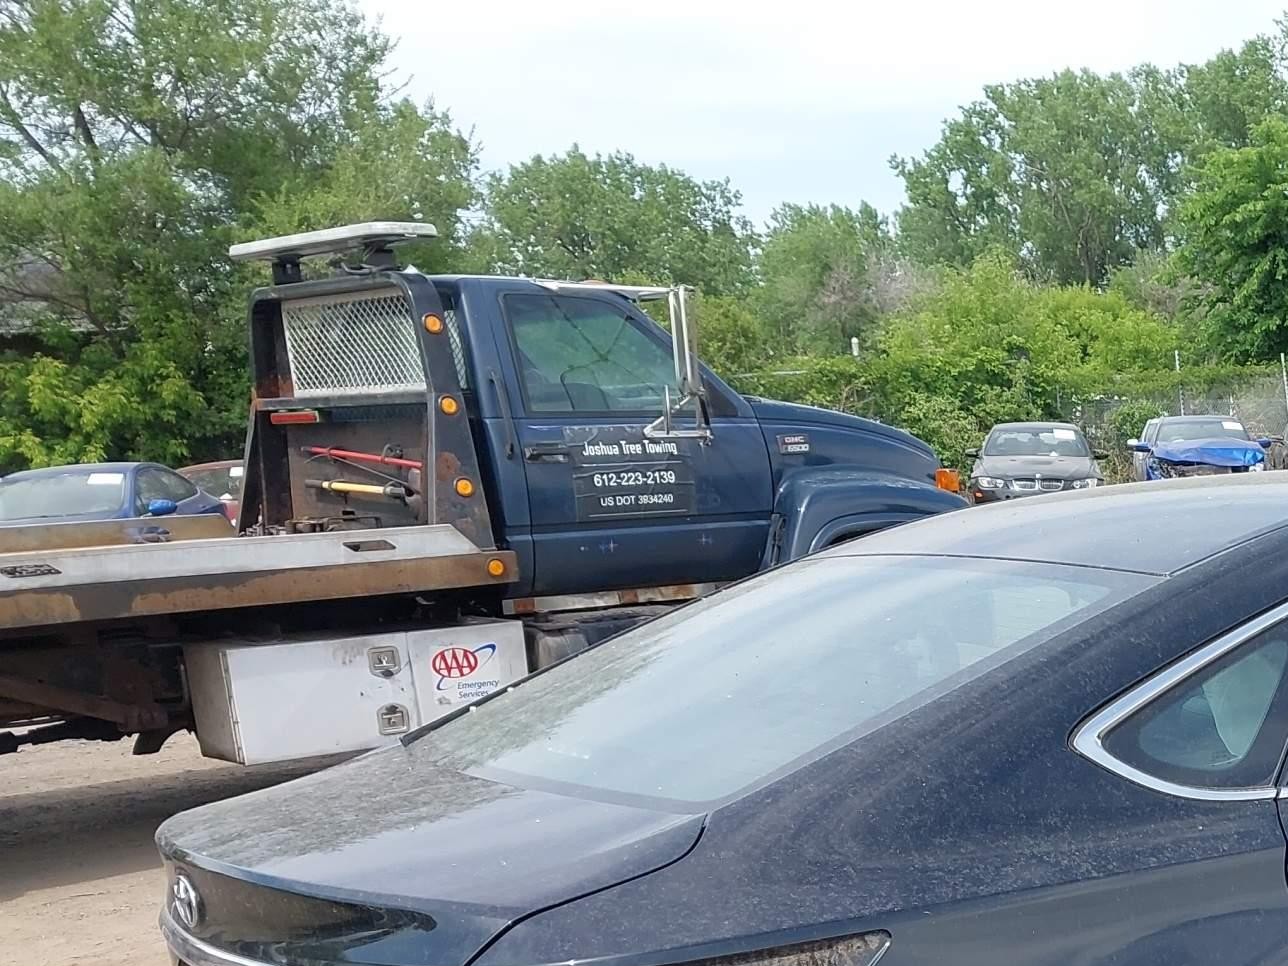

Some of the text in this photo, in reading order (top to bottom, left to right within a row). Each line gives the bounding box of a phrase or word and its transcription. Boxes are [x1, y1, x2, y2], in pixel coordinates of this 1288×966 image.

[582, 439, 678, 456] Joshua Tree Towing
[593, 471, 676, 487] 612-223-2139
[600, 496, 615, 506] US
[616, 495, 636, 505] DOT
[436, 648, 475, 678] AAA
[457, 679, 499, 690] Emergency
[458, 690, 489, 699] Services
